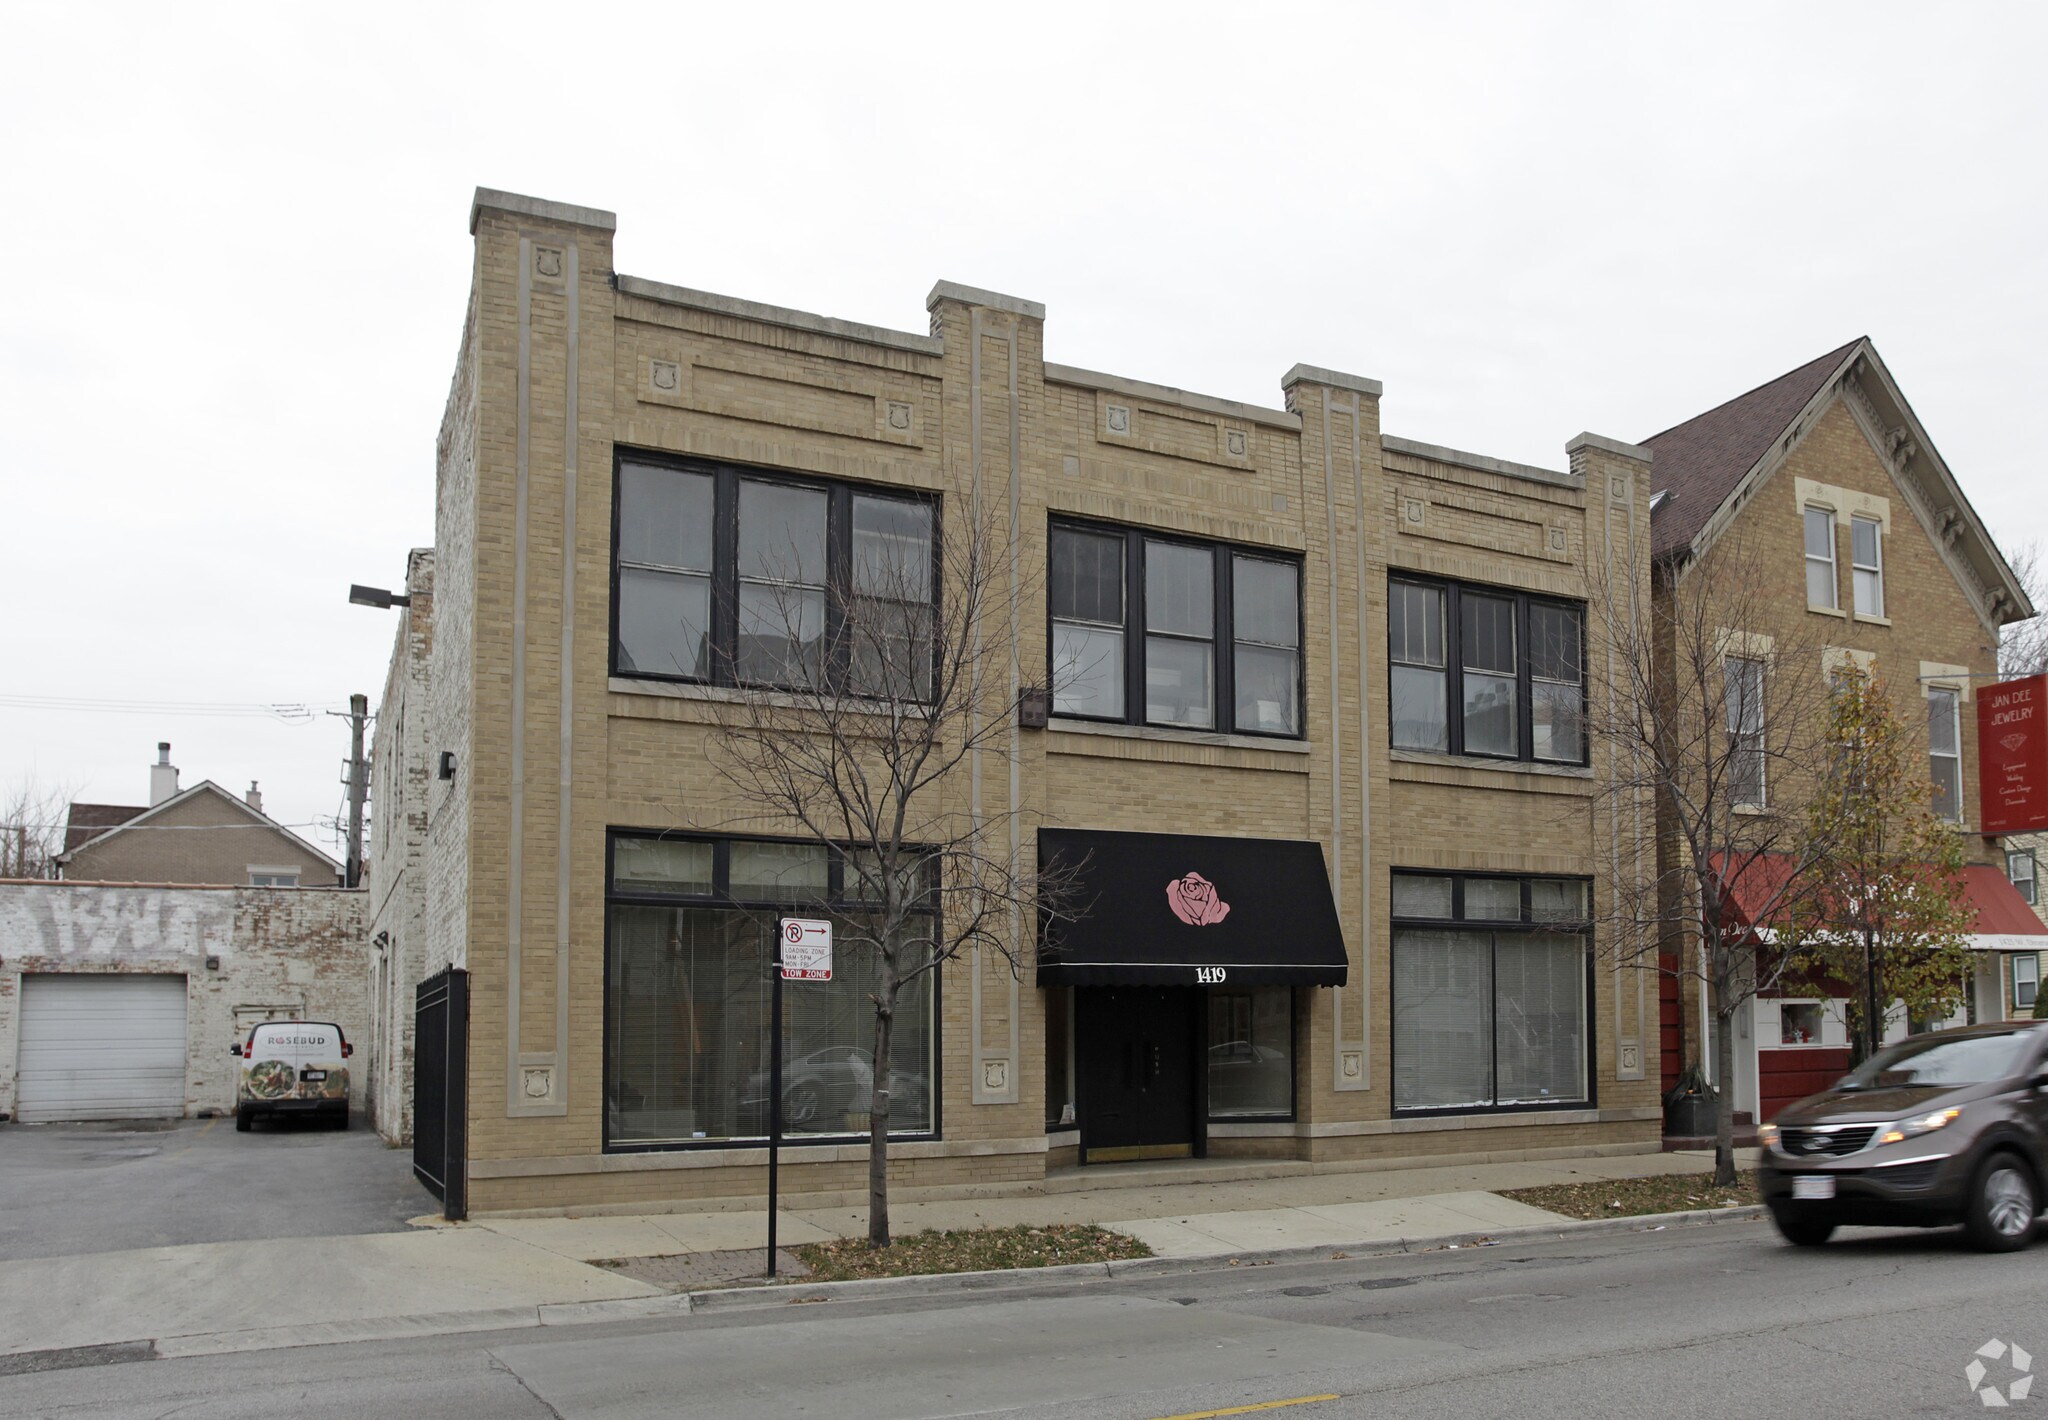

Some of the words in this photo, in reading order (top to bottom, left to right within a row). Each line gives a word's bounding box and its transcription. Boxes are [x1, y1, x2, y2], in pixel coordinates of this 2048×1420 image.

[1991, 694, 2010, 708] JAN
[2012, 689, 2032, 704] DEE
[1991, 706, 2034, 726] JEWELRY
[785, 947, 808, 955] LOADING
[785, 969, 802, 977] TOW
[806, 969, 827, 978] ZONE
[1195, 966, 1227, 983] 1419
[268, 1036, 325, 1045] ROSEBUD
